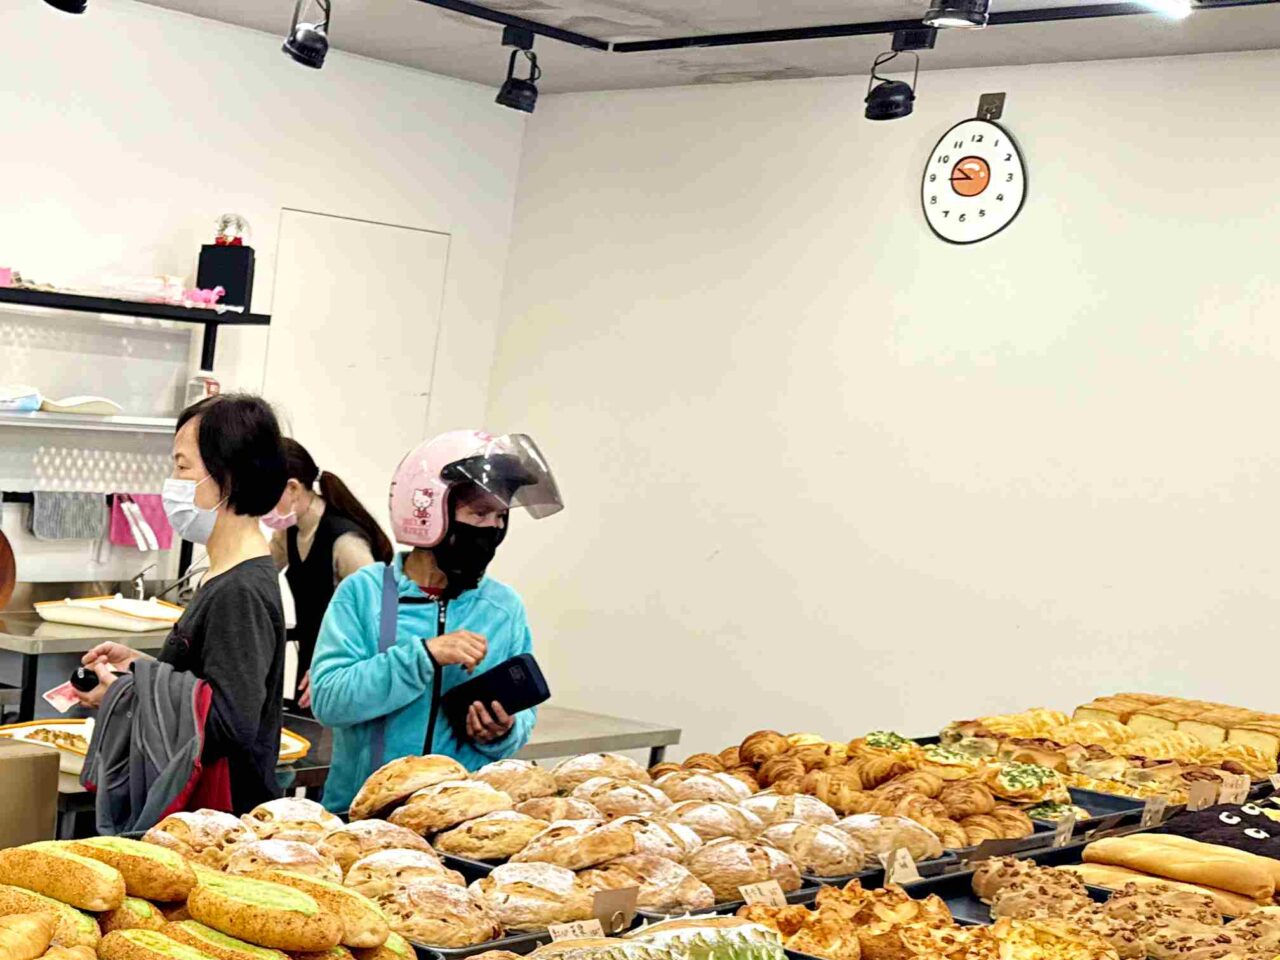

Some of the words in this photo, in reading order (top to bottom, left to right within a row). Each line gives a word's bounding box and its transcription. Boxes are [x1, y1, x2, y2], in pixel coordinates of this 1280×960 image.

[971, 134, 984, 143] 12
[954, 141, 963, 149] 11
[937, 155, 950, 164] 10
[1004, 153, 1012, 162] 2
[929, 173, 936, 182] 9
[1006, 173, 1013, 182] 3
[930, 196, 937, 205] 8
[996, 194, 1004, 202] 4
[942, 210, 949, 218] 7
[958, 213, 966, 222] 6
[978, 209, 986, 217] 5
